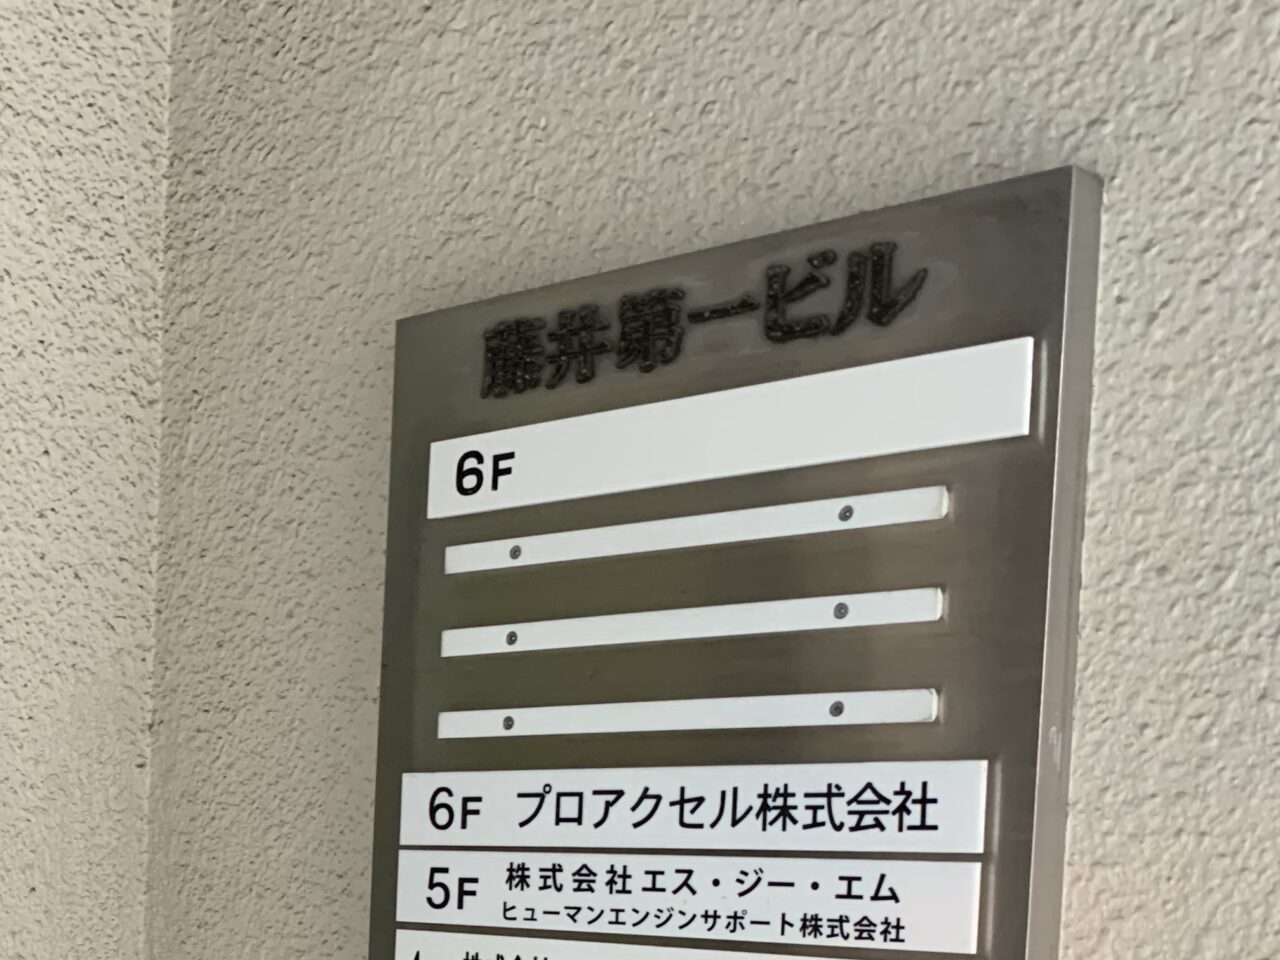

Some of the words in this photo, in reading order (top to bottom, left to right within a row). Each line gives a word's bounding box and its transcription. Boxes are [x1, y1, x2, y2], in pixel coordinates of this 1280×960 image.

[480, 241, 929, 400] 藤井第一ビル
[455, 450, 516, 497] 6F
[428, 786, 483, 831] 6F
[516, 780, 939, 833] プロアクセル株式会社
[425, 866, 479, 910] 5F
[505, 861, 901, 904] 株式会社エス・ジー・エム
[502, 901, 906, 943] ヒューマンエンジンサポート株式会社
